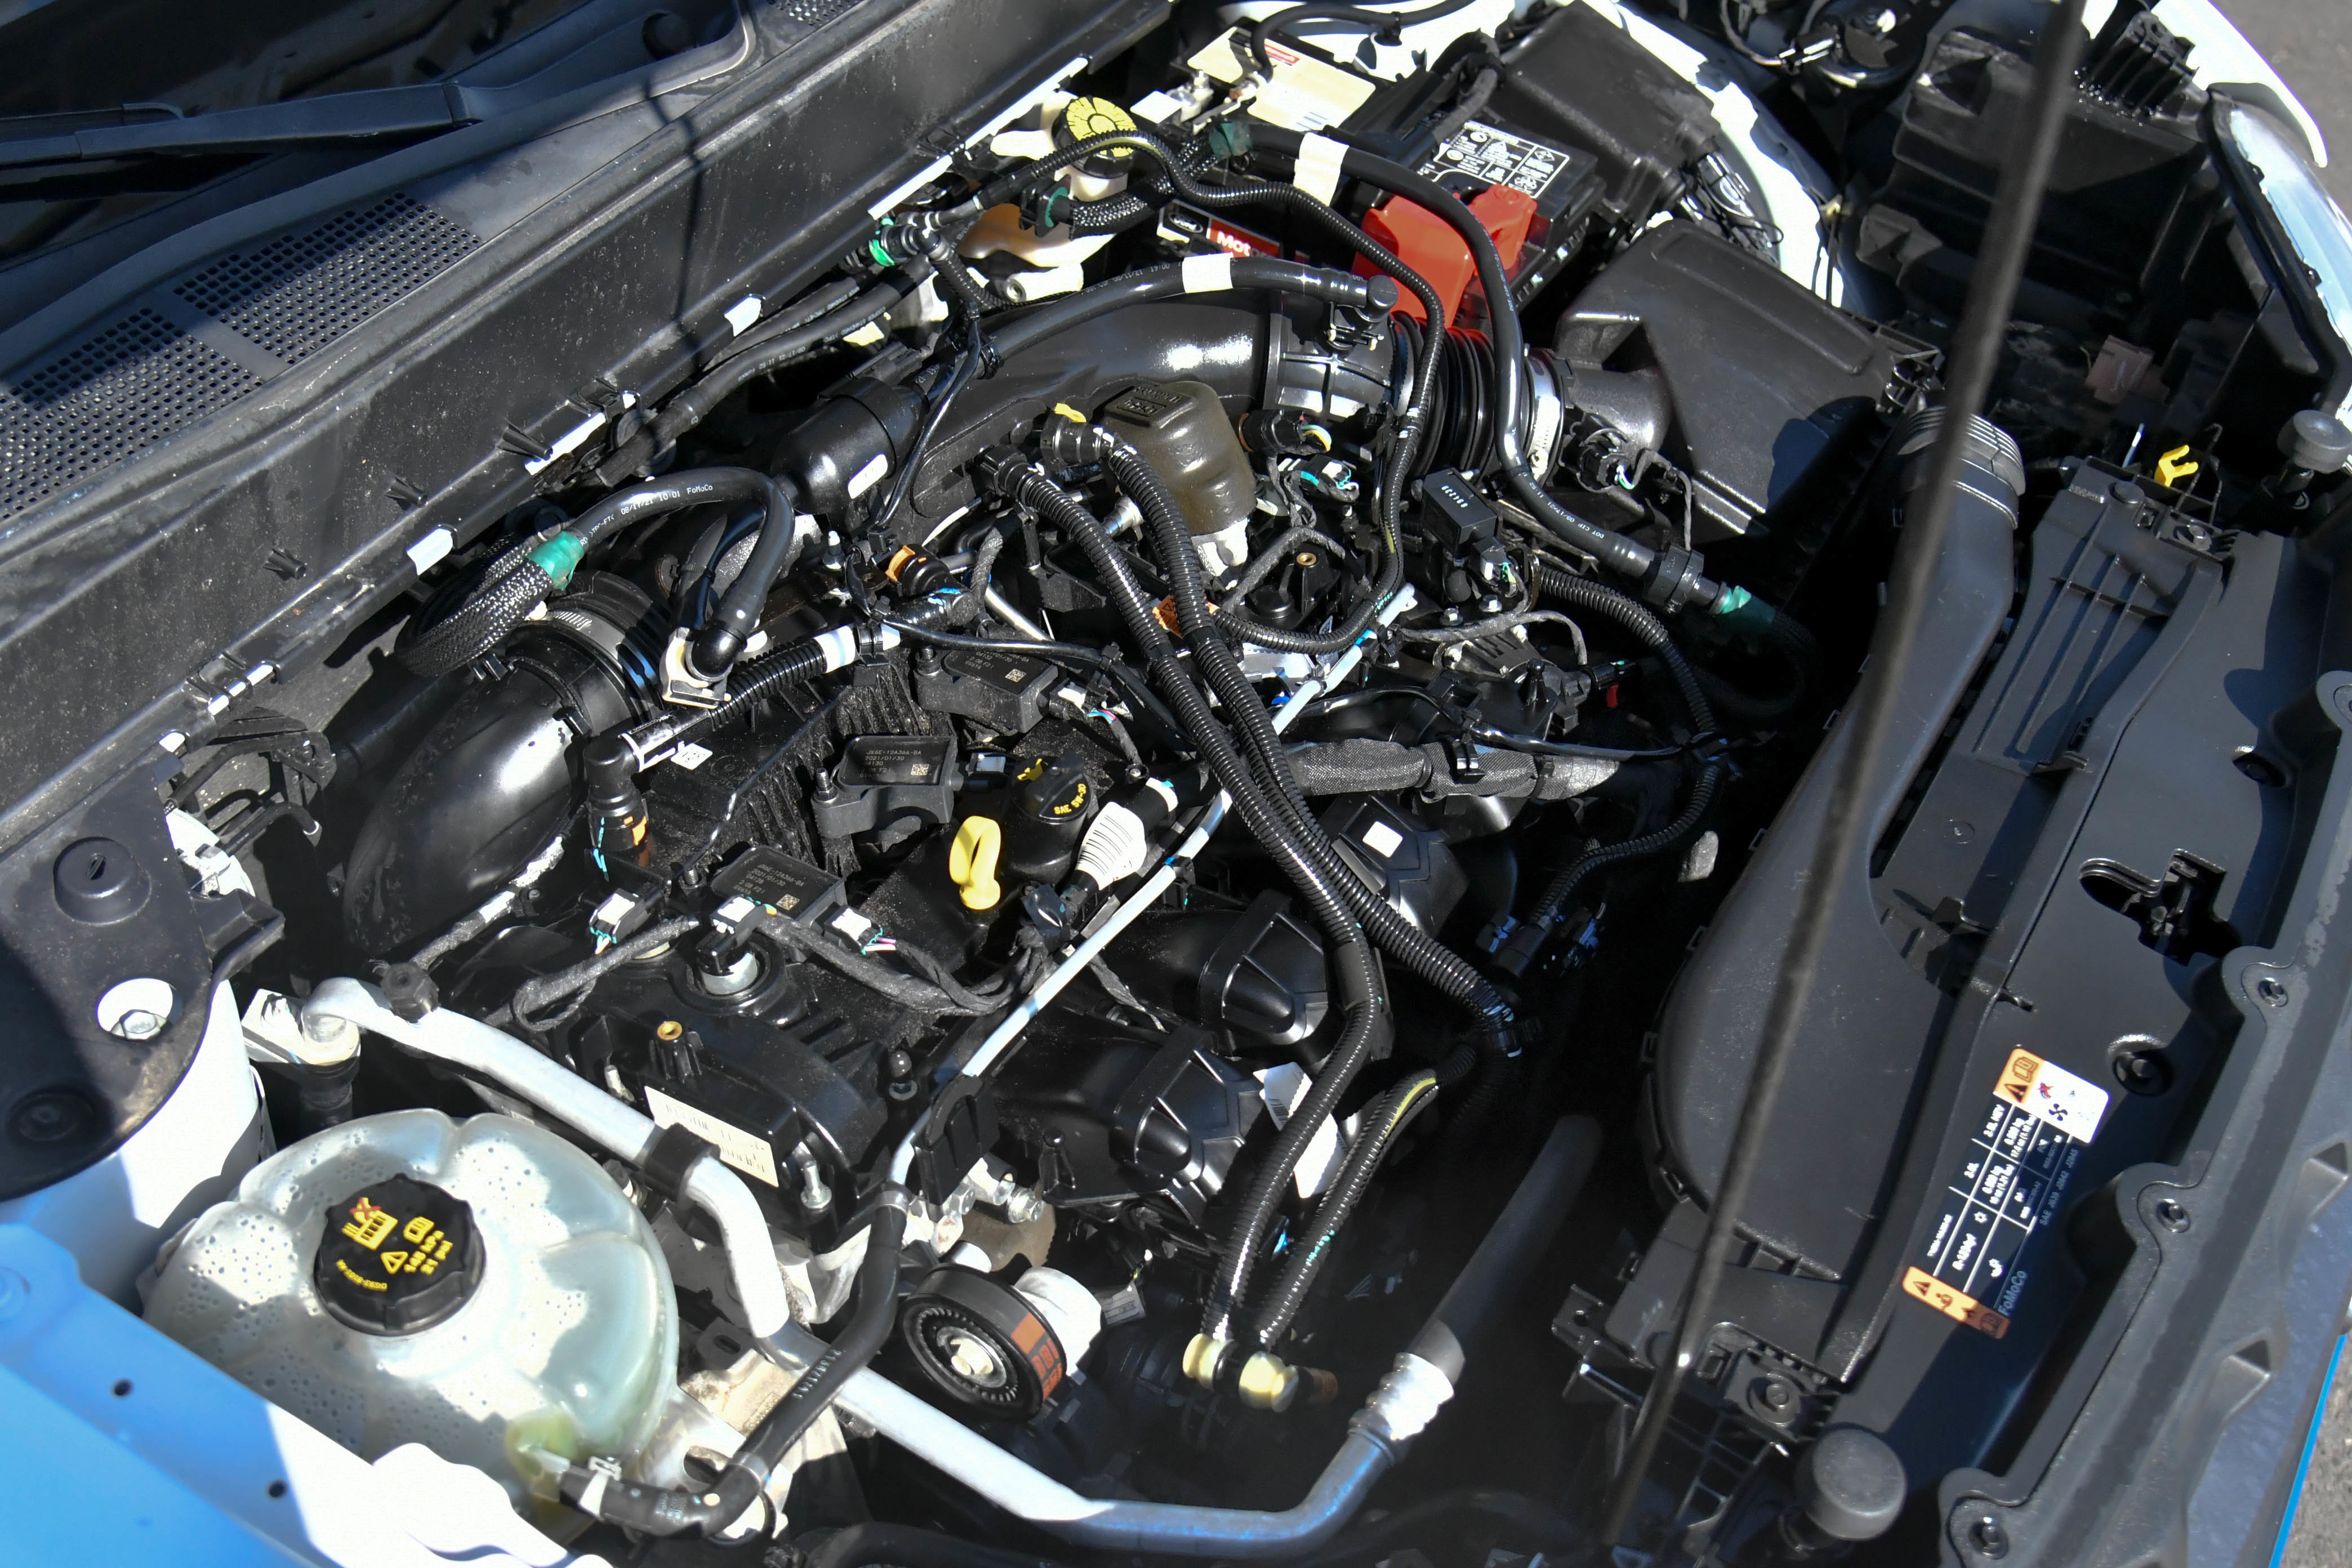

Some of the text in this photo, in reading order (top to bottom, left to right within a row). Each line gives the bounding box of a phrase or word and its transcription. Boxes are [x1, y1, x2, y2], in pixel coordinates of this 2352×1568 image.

[686, 484, 712, 495] FoMoCo
[1577, 522, 1590, 531] CIP
[1591, 529, 1604, 538] DOT
[1054, 784, 1086, 814] SAE 5W-30
[2038, 1209, 2052, 1226] SAE
[1998, 1269, 2027, 1317] FoMoCo
